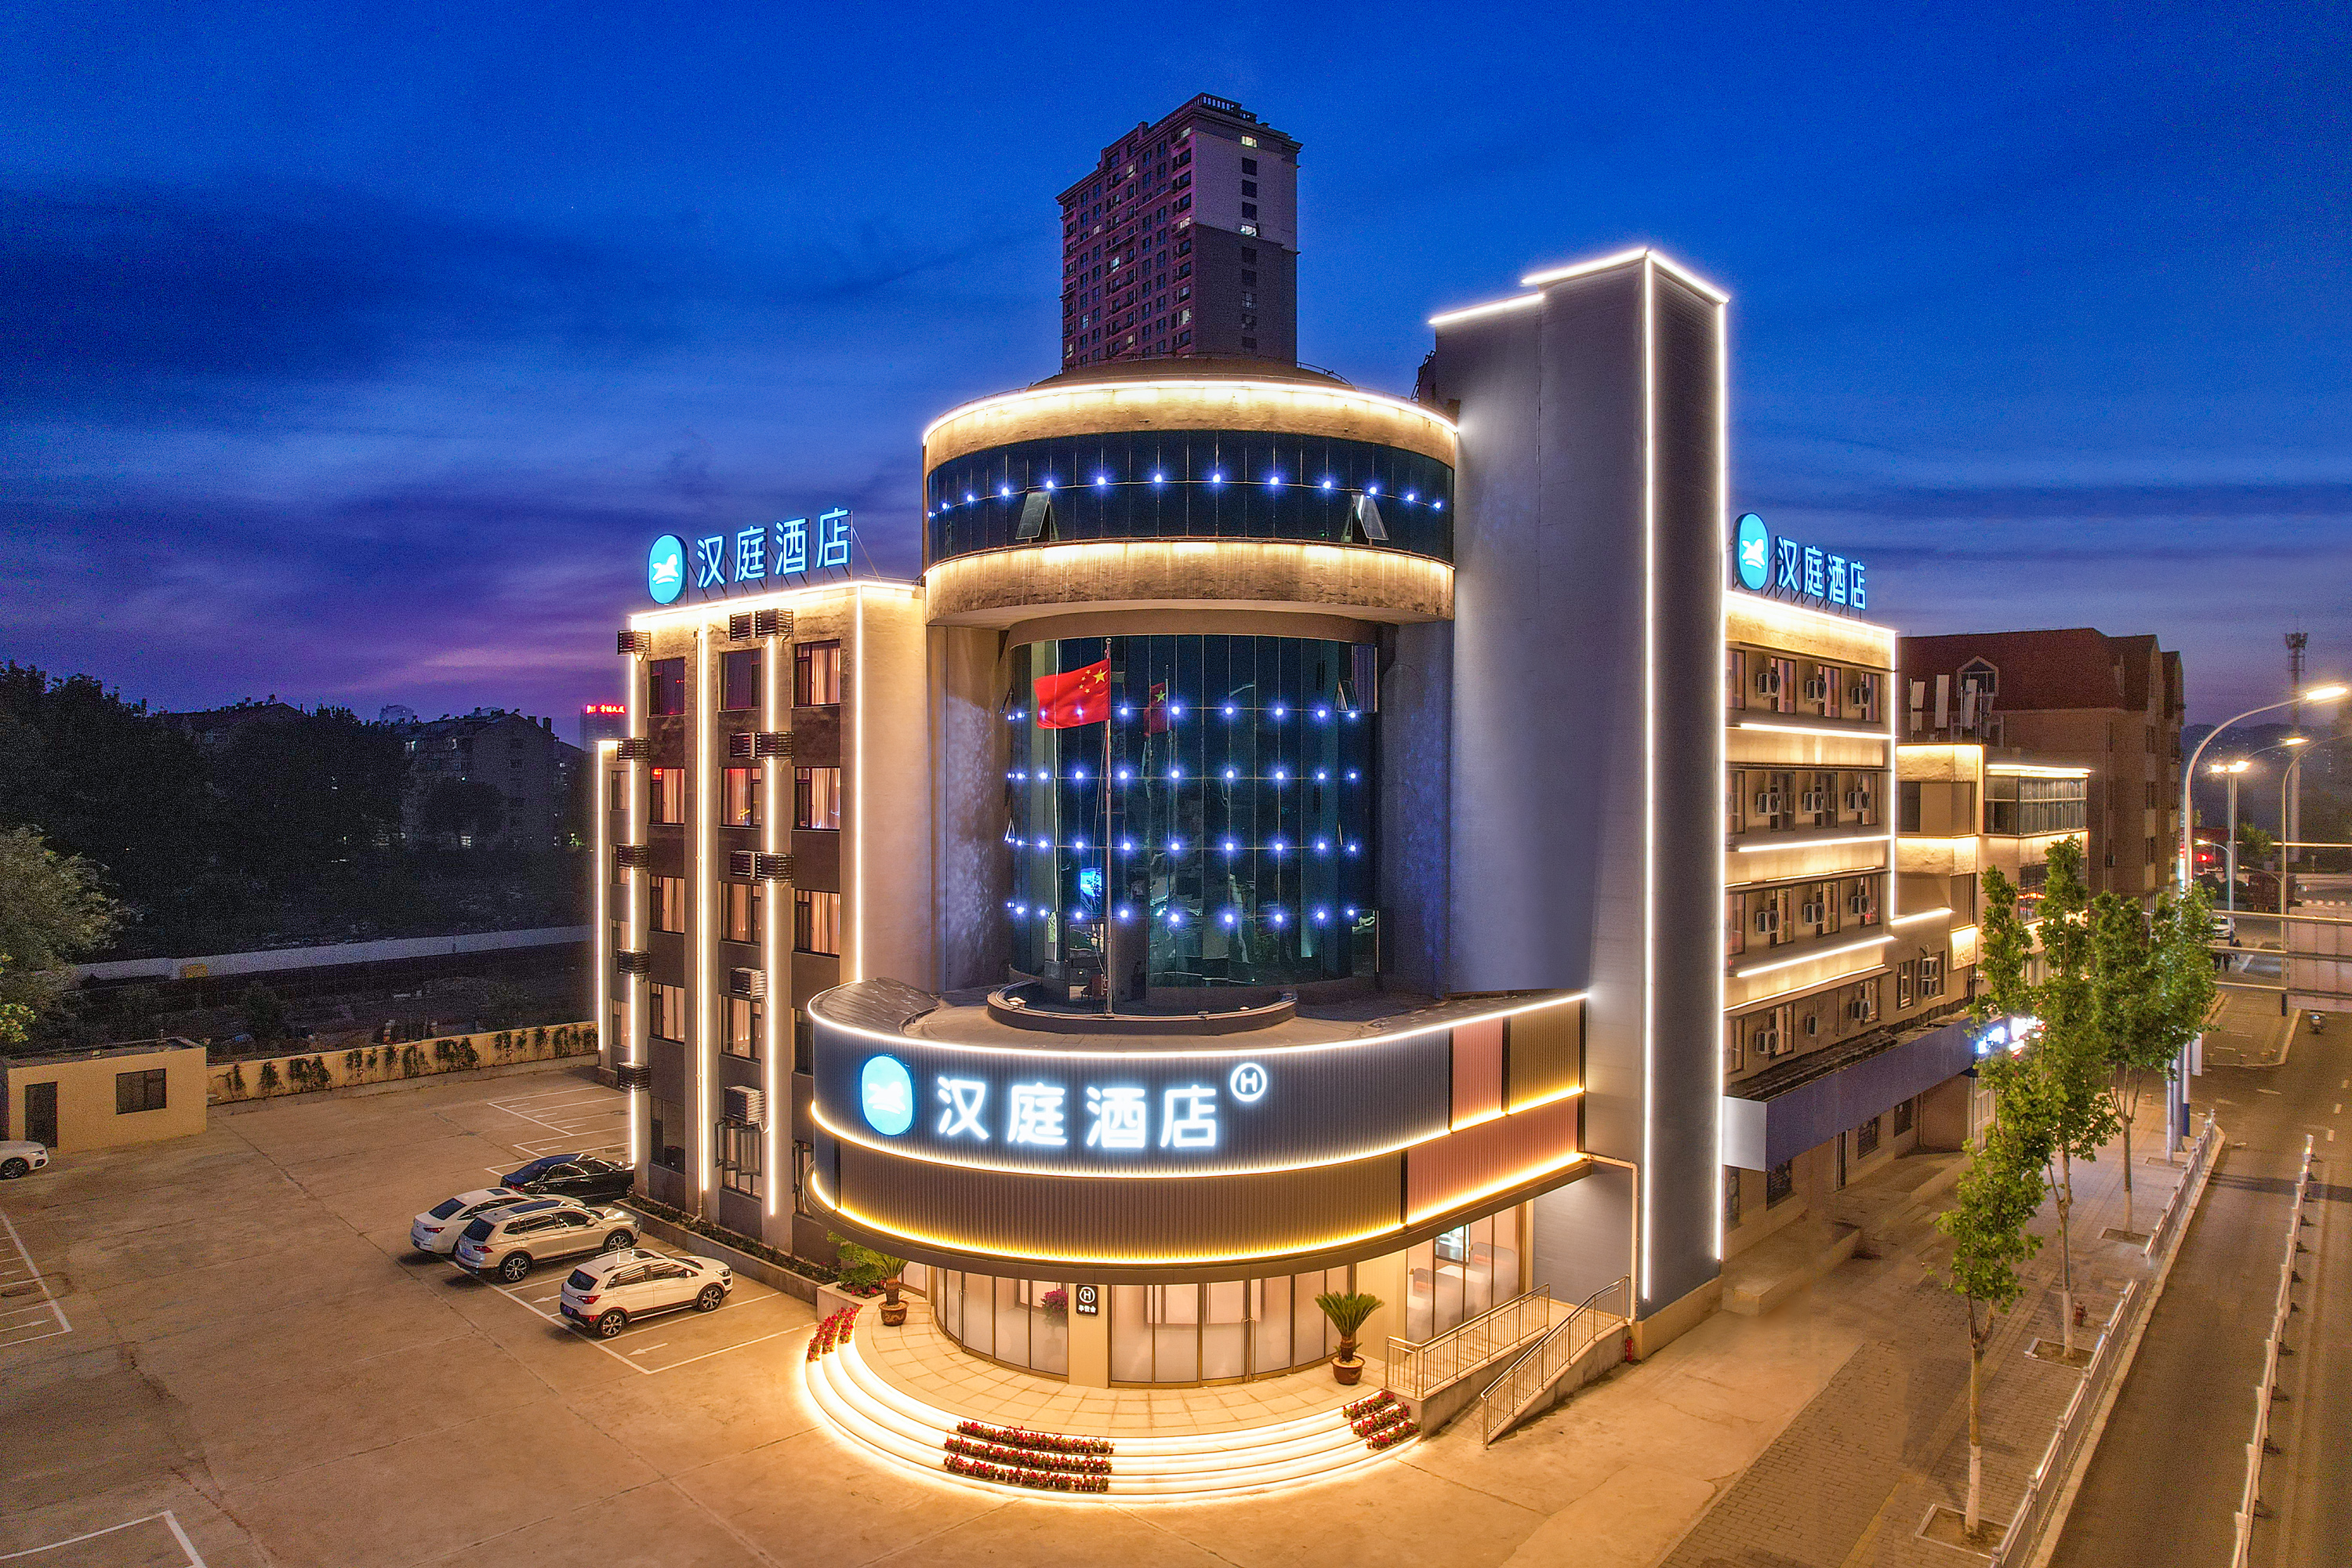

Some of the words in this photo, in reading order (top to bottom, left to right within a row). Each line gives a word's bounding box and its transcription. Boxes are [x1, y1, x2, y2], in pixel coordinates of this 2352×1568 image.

[697, 507, 850, 588] 汉庭酒店
[1777, 535, 1866, 610] 汉庭酒店
[937, 1075, 1218, 1149] 汉庭酒店
